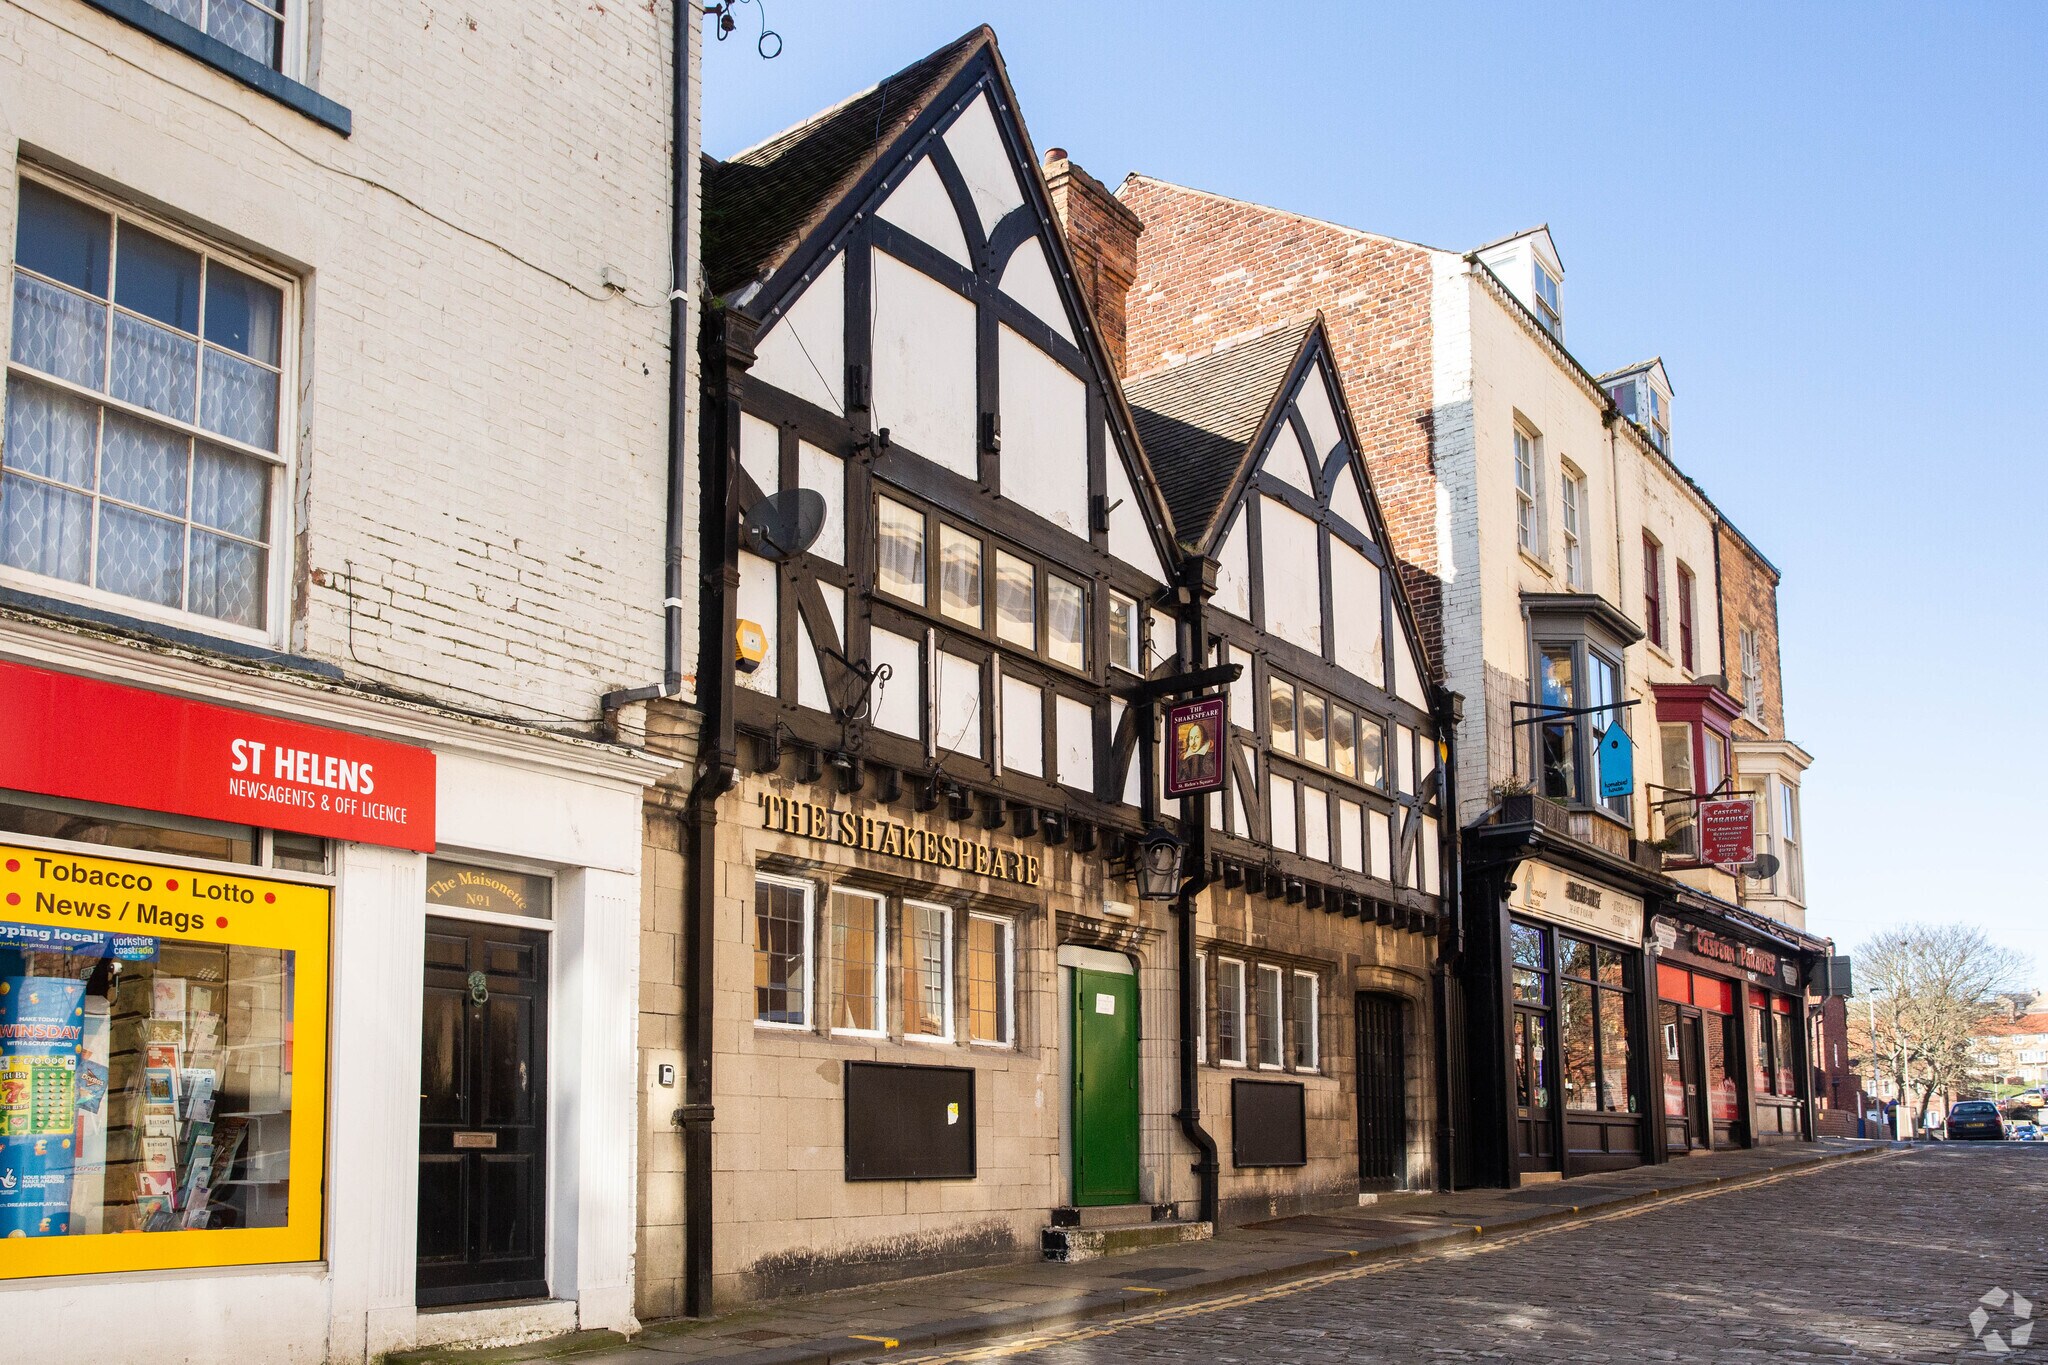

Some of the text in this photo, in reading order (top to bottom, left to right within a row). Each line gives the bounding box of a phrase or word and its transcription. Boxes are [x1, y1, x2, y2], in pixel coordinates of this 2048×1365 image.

[1174, 709, 1219, 723] SHAKESPEARE
[1190, 705, 1203, 713] THE
[231, 738, 374, 795] ST HELENS
[229, 778, 407, 824] NEWSAGENTS & OFF LICENCE
[761, 793, 1040, 886] THE SHAKESPEARE
[34, 857, 254, 904] Tobacco Lotto
[427, 871, 527, 910] The Maisonette
[35, 892, 204, 933] News / Mags
[54, 929, 104, 944] local!
[113, 936, 154, 946] yorkshire
[0, 1024, 82, 1039] WINSDAY
